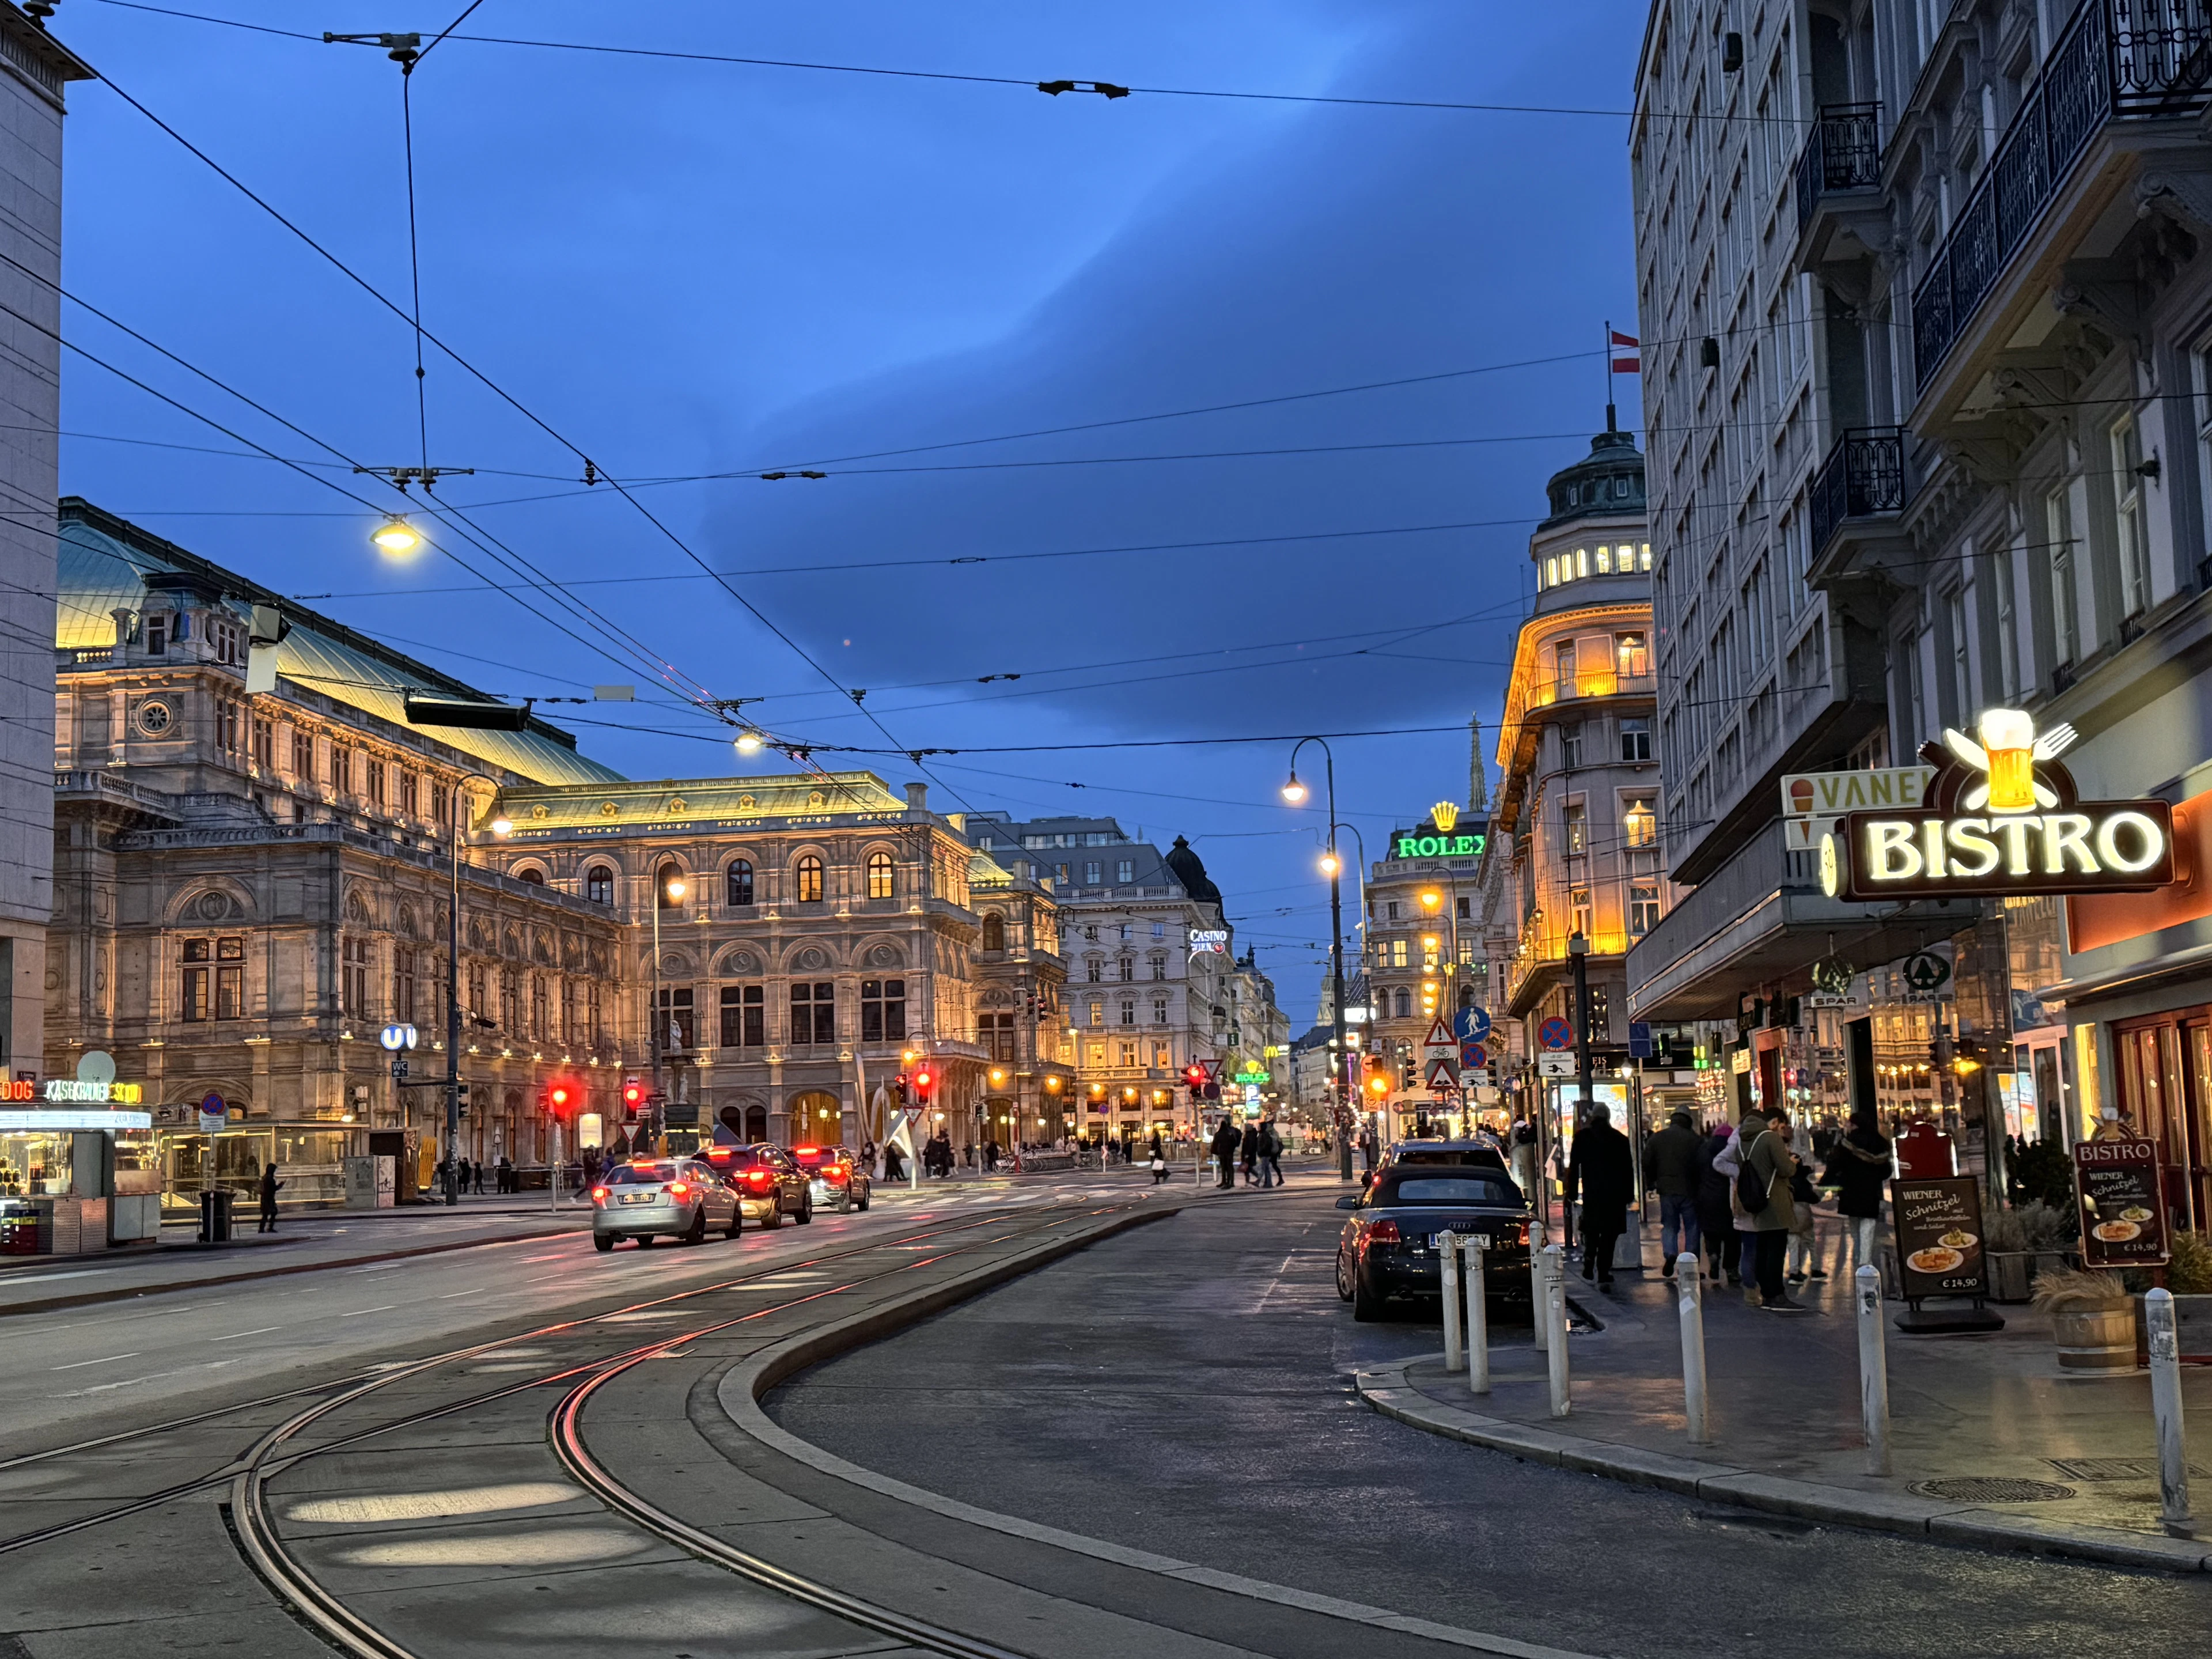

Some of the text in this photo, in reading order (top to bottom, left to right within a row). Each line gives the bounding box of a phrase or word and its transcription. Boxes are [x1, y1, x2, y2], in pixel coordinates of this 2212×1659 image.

[1397, 835, 1486, 858] ROLEX
[1867, 812, 2163, 880] BISTRO
[1190, 929, 1227, 942] CASINO
[1815, 997, 1857, 1006] SPAR
[384, 1028, 402, 1048] U
[392, 1062, 407, 1070] WC
[1234, 1073, 1270, 1083] ROLEX
[1, 1080, 35, 1101] DOG
[2080, 1143, 2151, 1161] BISTRO
[2089, 1171, 2124, 1181] WIENER
[1903, 1190, 1943, 1200] WIENER
[1906, 1194, 1961, 1221] Schnitzel
[2123, 1243, 2158, 1252] € 14,90
[1942, 1278, 1978, 1288] € 14,90
